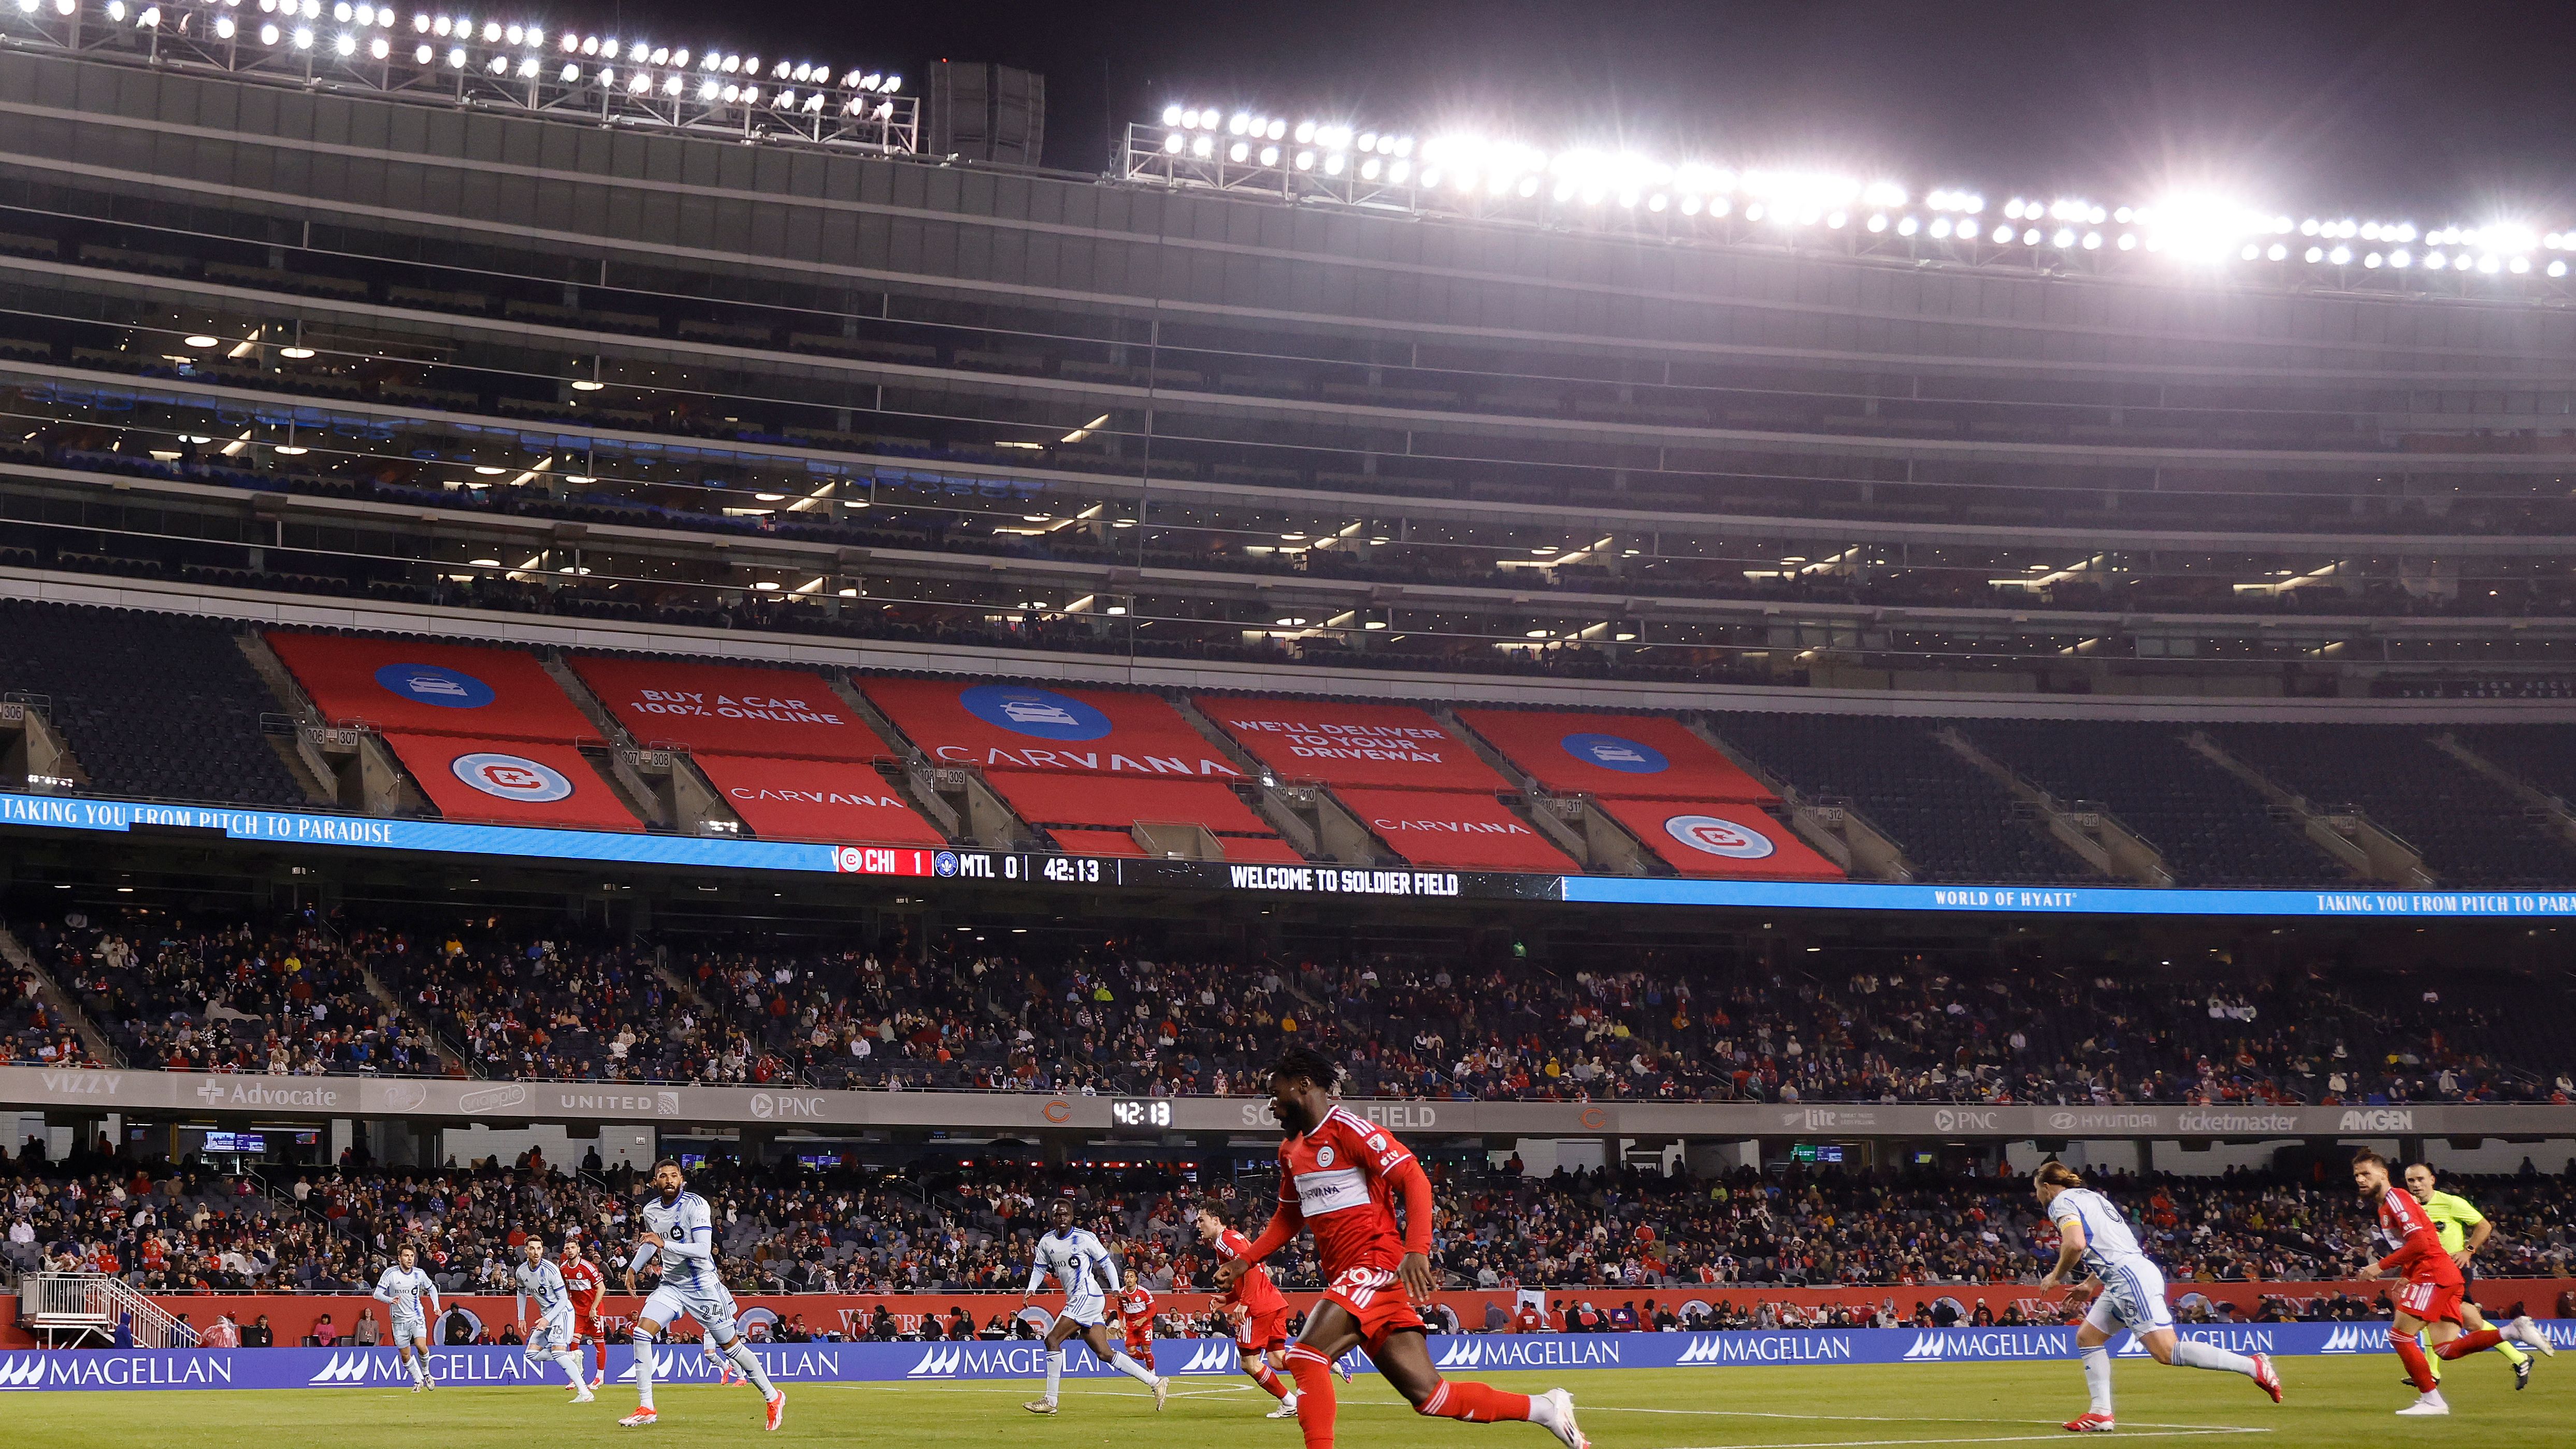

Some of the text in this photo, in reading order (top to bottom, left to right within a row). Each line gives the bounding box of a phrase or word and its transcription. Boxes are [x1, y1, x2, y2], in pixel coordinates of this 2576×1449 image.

[641, 690, 811, 710] BUY A CAR
[4, 705, 21, 719] 306
[631, 702, 844, 725] 100% ONLINE
[340, 731, 356, 744] 307
[1319, 724, 1446, 739] DELIVER
[1285, 734, 1420, 750] TO YOUR
[622, 751, 638, 764] 307
[653, 753, 669, 766] 308
[936, 745, 1241, 776] CARVANA
[1290, 746, 1443, 763] DRIVEWAY
[949, 771, 964, 783] 309
[731, 787, 904, 808] CARVANA
[1567, 801, 1581, 812] 311
[2, 798, 393, 843] TAKING YOU FROM PITCH TO PARADISE
[1829, 809, 1842, 820] 312
[1374, 819, 1531, 834] CARVANA
[866, 849, 895, 873] CHI
[913, 851, 921, 874] 1
[960, 853, 995, 878] MTL
[1005, 856, 1017, 879] 0
[1043, 858, 1100, 882] 42:13
[1230, 866, 1459, 896] WELCOME TO SOLDIER FIELD
[1934, 891, 1989, 906] WORLD
[1995, 892, 2014, 906] OF
[2316, 895, 2373, 911] TAKING
[2376, 895, 2408, 911] YOU
[2413, 895, 2457, 912] FROM
[2461, 896, 2508, 912] PITCH
[2512, 896, 2534, 912] TO
[41, 1072, 121, 1095] VIZZY
[230, 1082, 337, 1107] Advocate
[560, 1095, 652, 1110] UNITED
[778, 1096, 826, 1117] PNC
[1114, 1101, 1171, 1126] 42:13
[1368, 1107, 1436, 1128] FIELD
[1805, 1109, 1836, 1131] Lite
[1958, 1112, 1998, 1129] PNC
[2082, 1114, 2157, 1128] HYUNDAI
[2179, 1111, 2297, 1132] ticketmaster
[2339, 1110, 2413, 1130] AMGEN
[700, 1303, 724, 1320] 24
[553, 1326, 564, 1335] 16
[2181, 1330, 2274, 1351] AGELLAN
[1485, 1341, 1620, 1366] MAGELLAN
[1723, 1336, 1850, 1361] MAGELLAN
[1947, 1333, 2067, 1358] MAGELLAN
[49, 1356, 232, 1386] MAGELLAN
